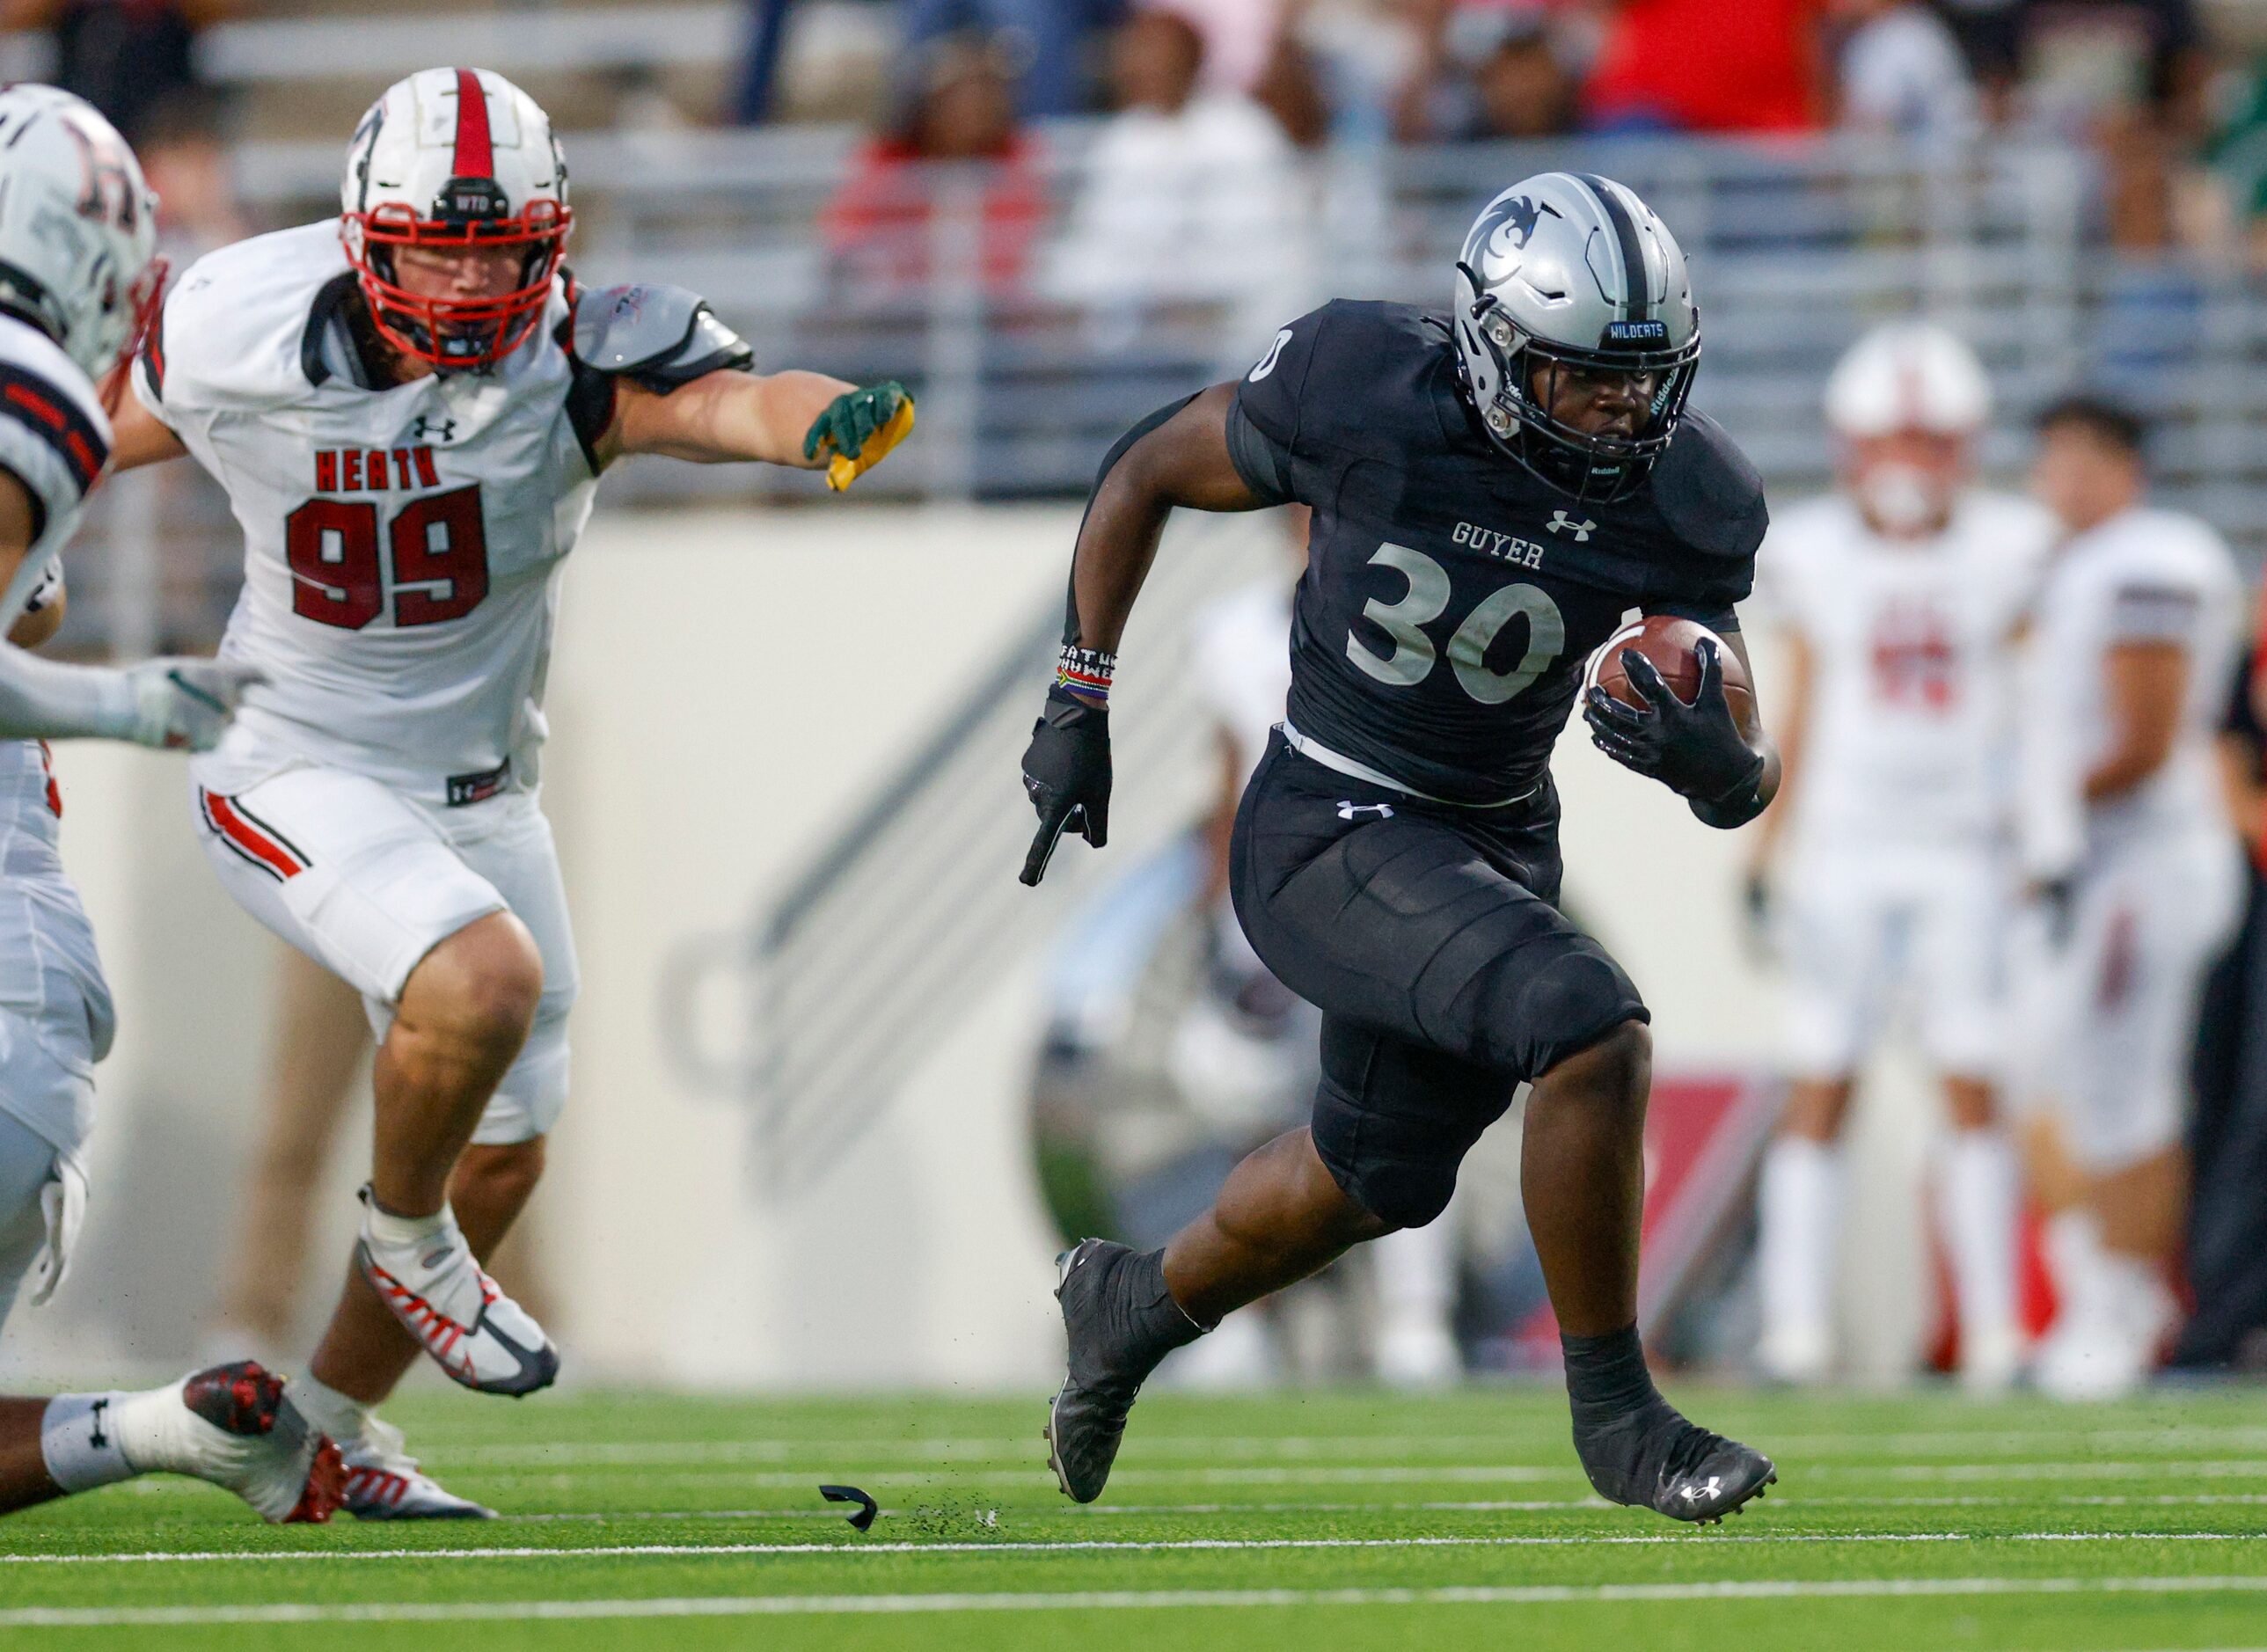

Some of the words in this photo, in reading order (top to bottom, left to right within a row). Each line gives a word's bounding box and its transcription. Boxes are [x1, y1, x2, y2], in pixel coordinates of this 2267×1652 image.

[1610, 323, 1664, 340] WILDCATS
[314, 445, 441, 493] HEATH
[285, 483, 490, 631] 99
[1452, 521, 1546, 571] GUYER
[1345, 541, 1566, 705] 30
